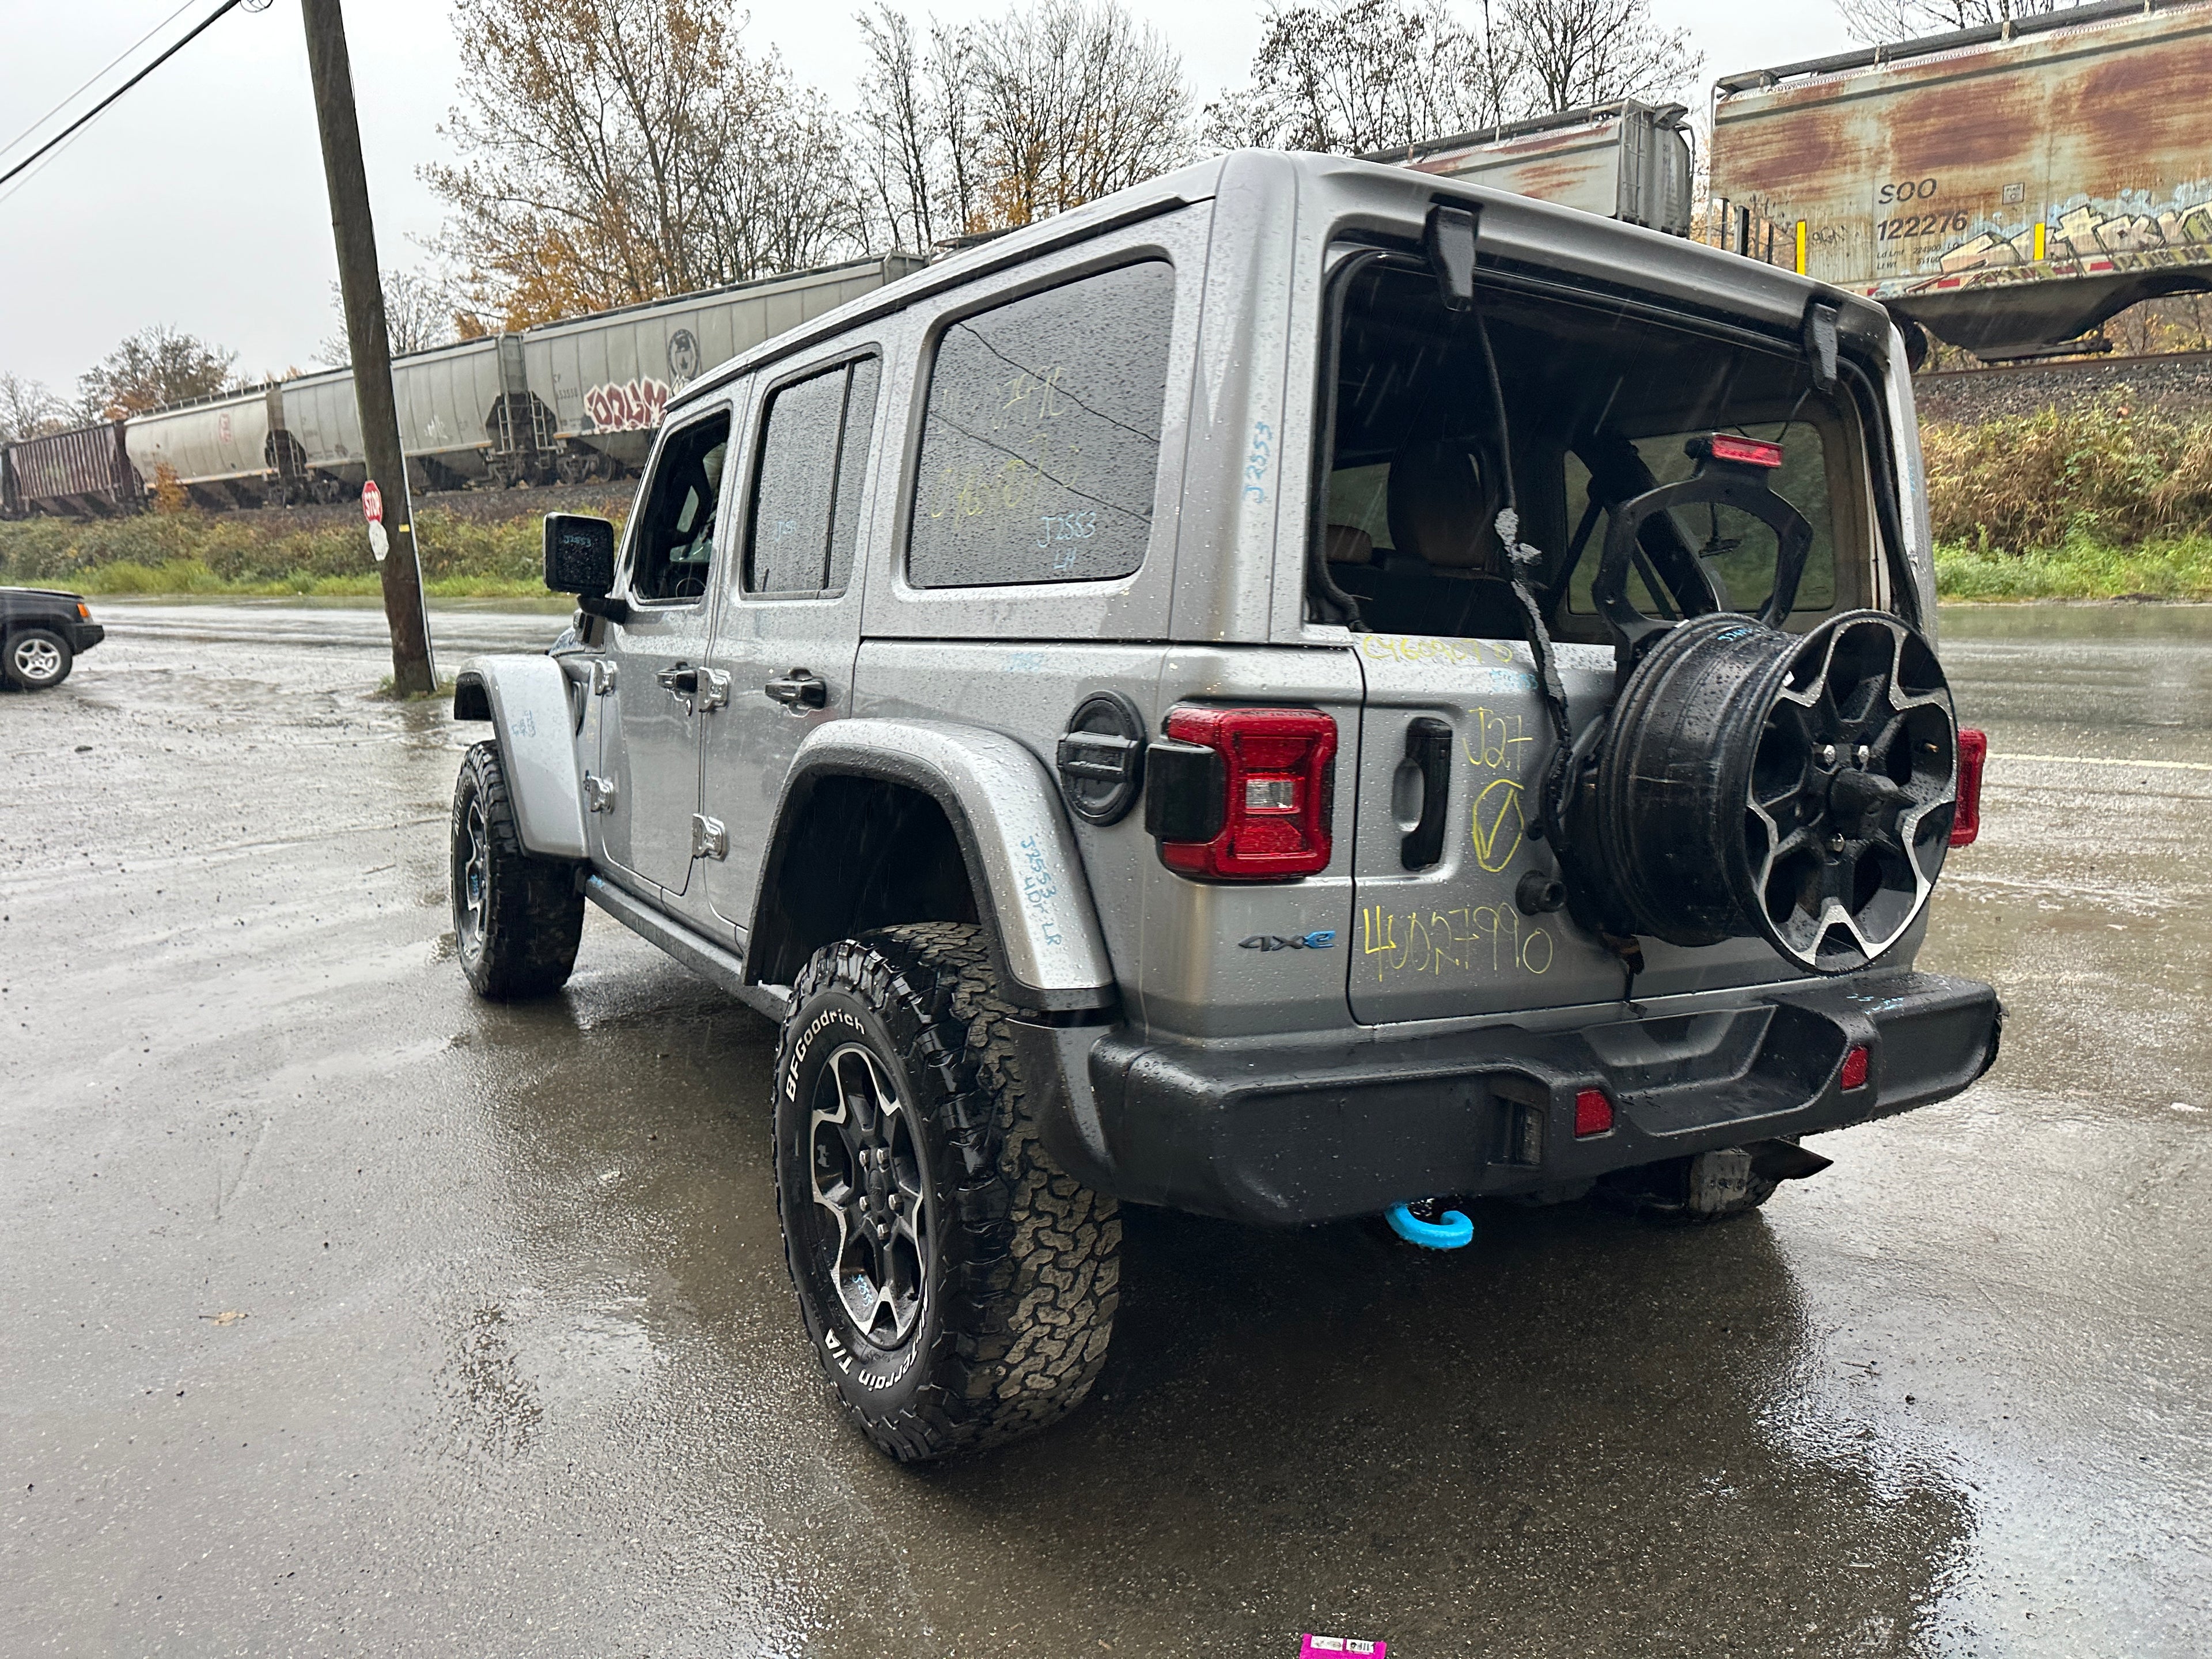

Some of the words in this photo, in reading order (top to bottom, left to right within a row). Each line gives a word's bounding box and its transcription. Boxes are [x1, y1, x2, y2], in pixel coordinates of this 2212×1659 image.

[1878, 178, 1937, 204] SOO
[1877, 210, 1968, 241] 122276
[364, 490, 380, 517] STOP
[1037, 512, 1096, 548] J2553
[1462, 706, 1533, 771] J27
[1020, 835, 1057, 899] J2553
[786, 1009, 865, 1103] BFGoodrich
